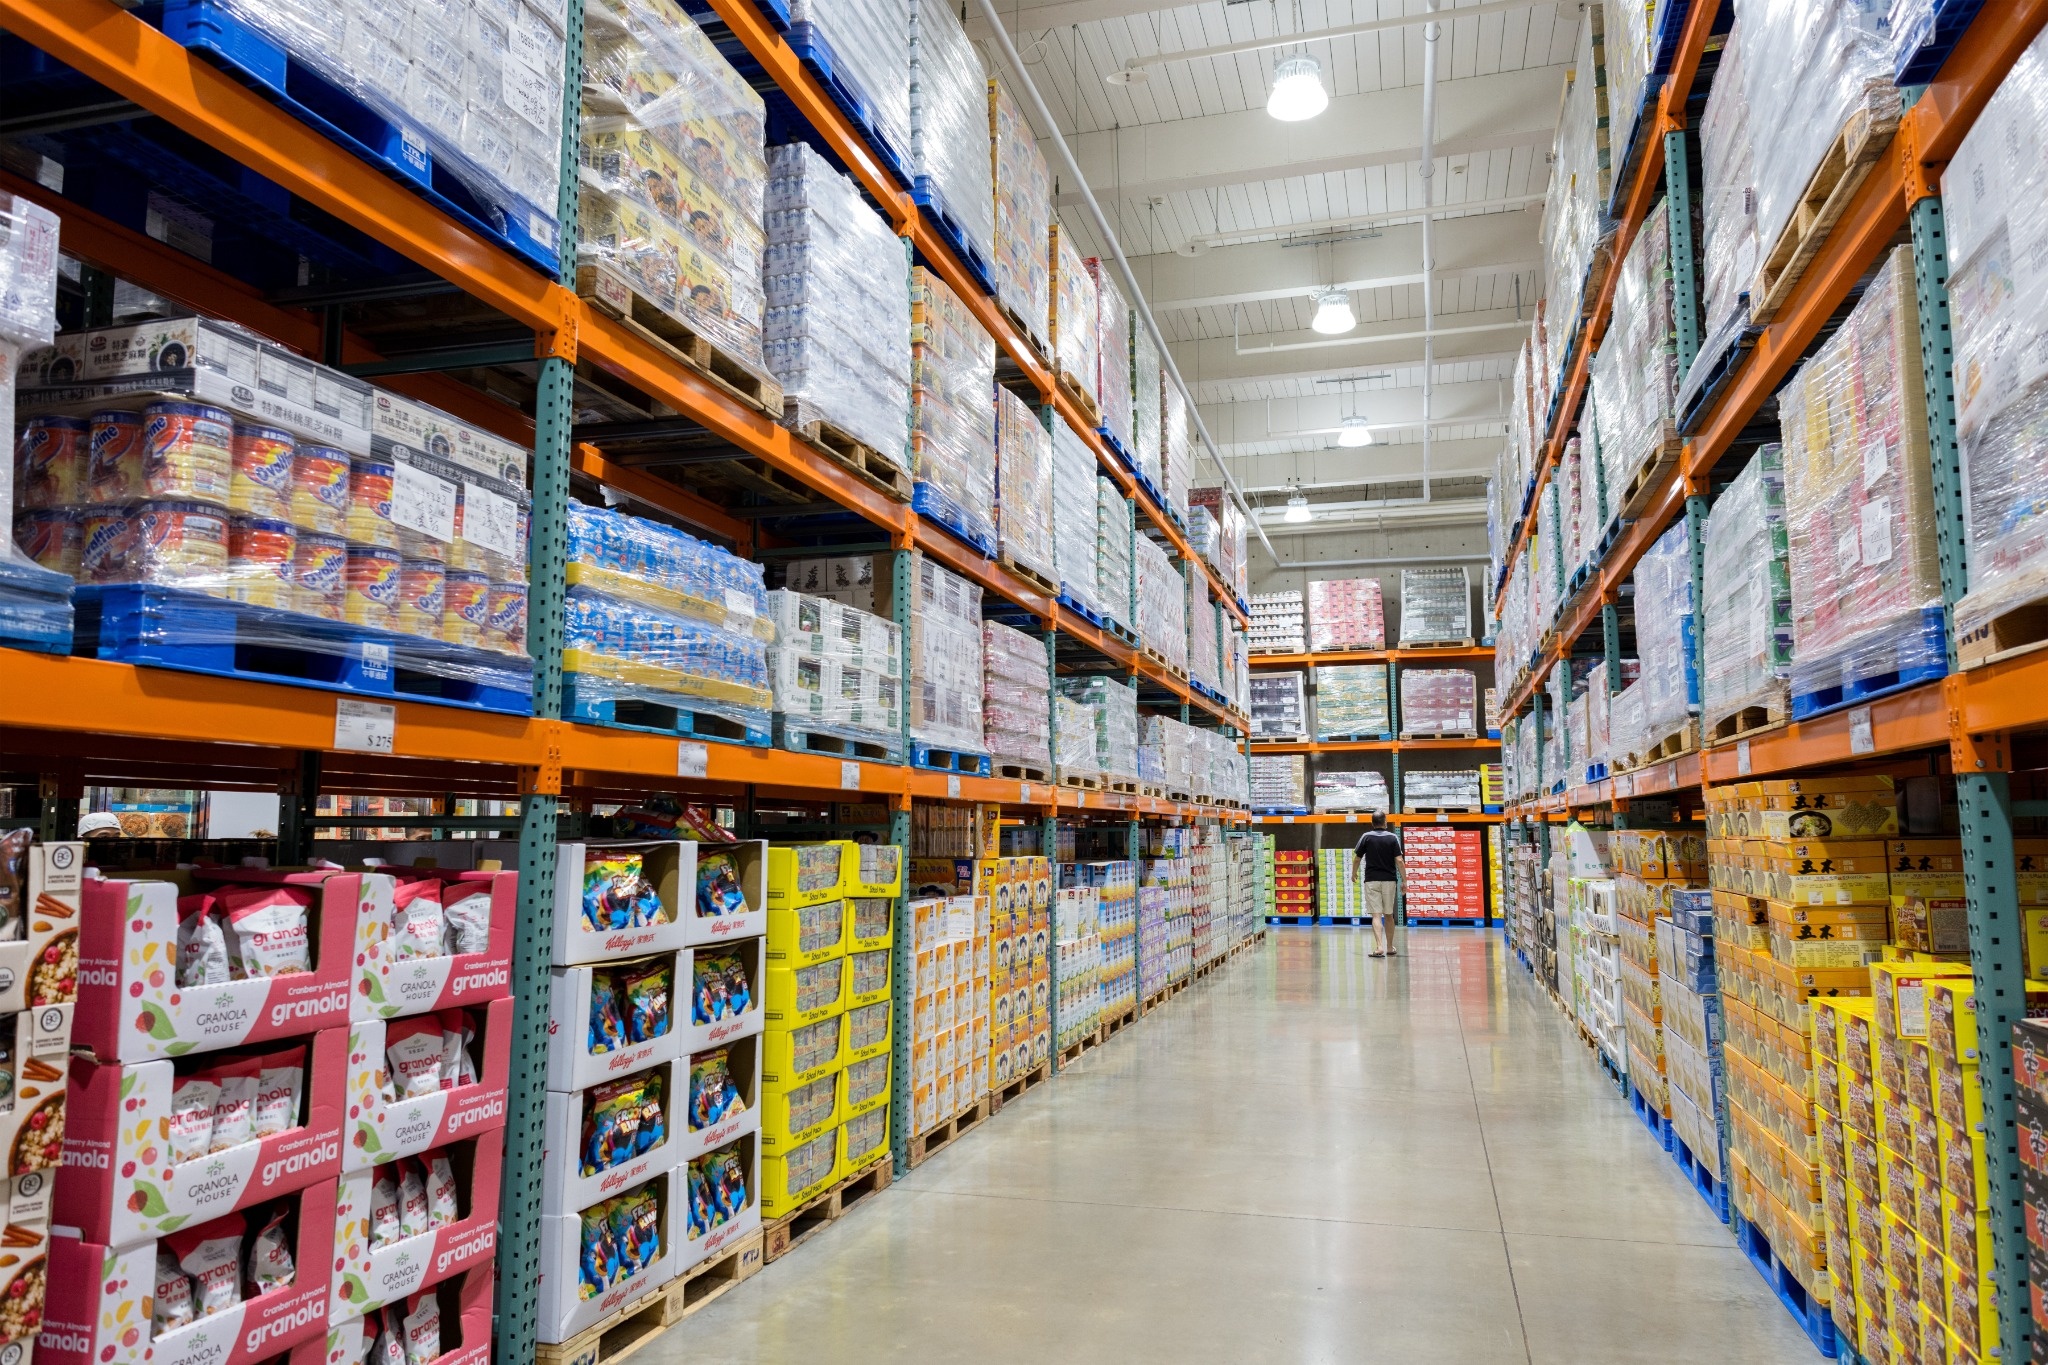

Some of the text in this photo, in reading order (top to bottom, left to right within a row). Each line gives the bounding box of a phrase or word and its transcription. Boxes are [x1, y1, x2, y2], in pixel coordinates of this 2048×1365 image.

[261, 401, 343, 441] 特濃核桃黑芝麻糊
[1791, 794, 1829, 811] 五木
[1798, 859, 1836, 875] 五木
[1895, 856, 1933, 872] 五木
[710, 921, 732, 935] Kellogg's
[1796, 924, 1835, 940] 五木
[605, 935, 636, 951] Kellogg's
[464, 959, 508, 971] Cranberry Almond
[288, 979, 349, 997] Cranberry Almond
[400, 980, 436, 994] GRANOLA
[452, 968, 508, 996] granola
[406, 991, 431, 1001] HOUSE
[196, 1009, 248, 1026] GRANOLA
[271, 991, 348, 1027] granola
[204, 1022, 241, 1035] HOUSE
[708, 1025, 729, 1040] Kellogg's
[609, 1052, 635, 1070] Kellogg's
[806, 1070, 825, 1081] School Pack
[459, 1089, 504, 1106] Cranberry Almond
[447, 1099, 503, 1133] granola
[395, 1121, 432, 1139] GRANOLA
[703, 1127, 725, 1146] Kellogg's
[802, 1127, 822, 1140] School Pack
[278, 1128, 340, 1153] Cranberry Almond
[401, 1133, 426, 1145] HOUSE
[262, 1141, 338, 1186] granola
[858, 1156, 867, 1166] School
[188, 1174, 239, 1198] GRANOLA
[600, 1171, 628, 1192] Kellogg's
[196, 1188, 233, 1206] HOUSE
[801, 1185, 822, 1200] School Pack
[448, 1220, 494, 1245] Cranberry Almond
[703, 1230, 725, 1251] Kellogg's
[437, 1231, 494, 1273] granola
[382, 1263, 420, 1285] GRANOLA
[388, 1275, 415, 1292] HOUSE
[263, 1285, 326, 1318] Cranberry Almond
[600, 1288, 628, 1312] Kellogg's
[246, 1299, 325, 1353] granola
[468, 1342, 488, 1358] Almond
